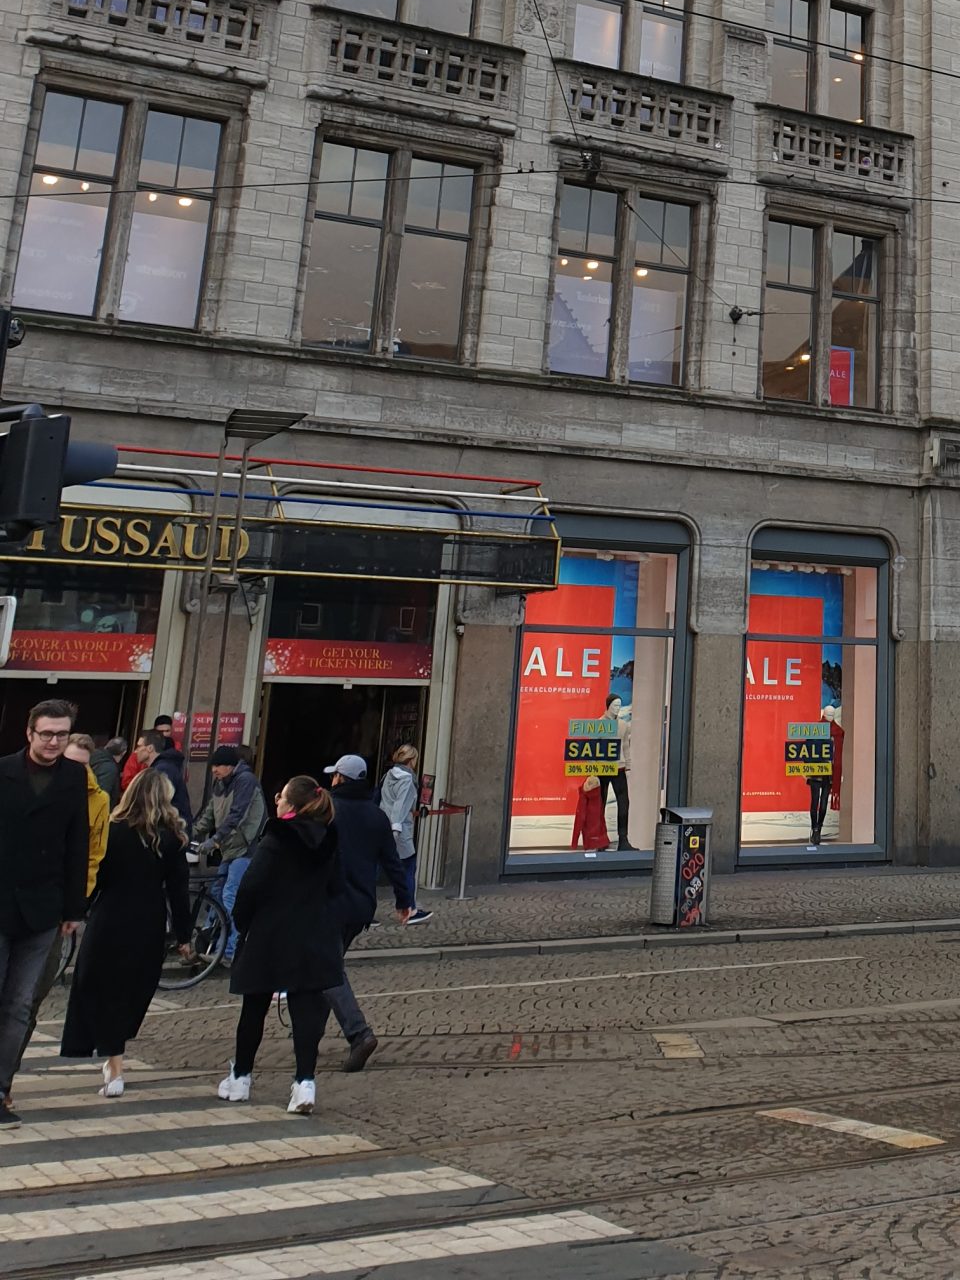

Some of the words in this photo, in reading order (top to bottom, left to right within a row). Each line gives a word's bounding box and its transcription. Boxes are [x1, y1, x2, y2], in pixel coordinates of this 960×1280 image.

[60, 639, 71, 651] A
[73, 640, 122, 652] WORLD
[22, 650, 78, 662] FAMOUS
[81, 651, 110, 663] FUN
[322, 647, 346, 658] GET
[348, 648, 380, 659] YOUR
[307, 658, 357, 668] TICKETS
[358, 659, 393, 670] HERE!
[524, 646, 601, 678] ALE
[196, 716, 239, 724] SUPSTAR
[571, 722, 614, 733] FINAL
[790, 725, 826, 736] FINAL
[568, 742, 617, 757] SALE
[788, 744, 831, 758] SALE
[568, 765, 582, 773] 30%
[585, 765, 599, 773] 50%
[601, 765, 615, 773] 70%
[788, 765, 800, 773] 30%
[802, 765, 814, 773] 50%
[817, 765, 829, 773] 70%
